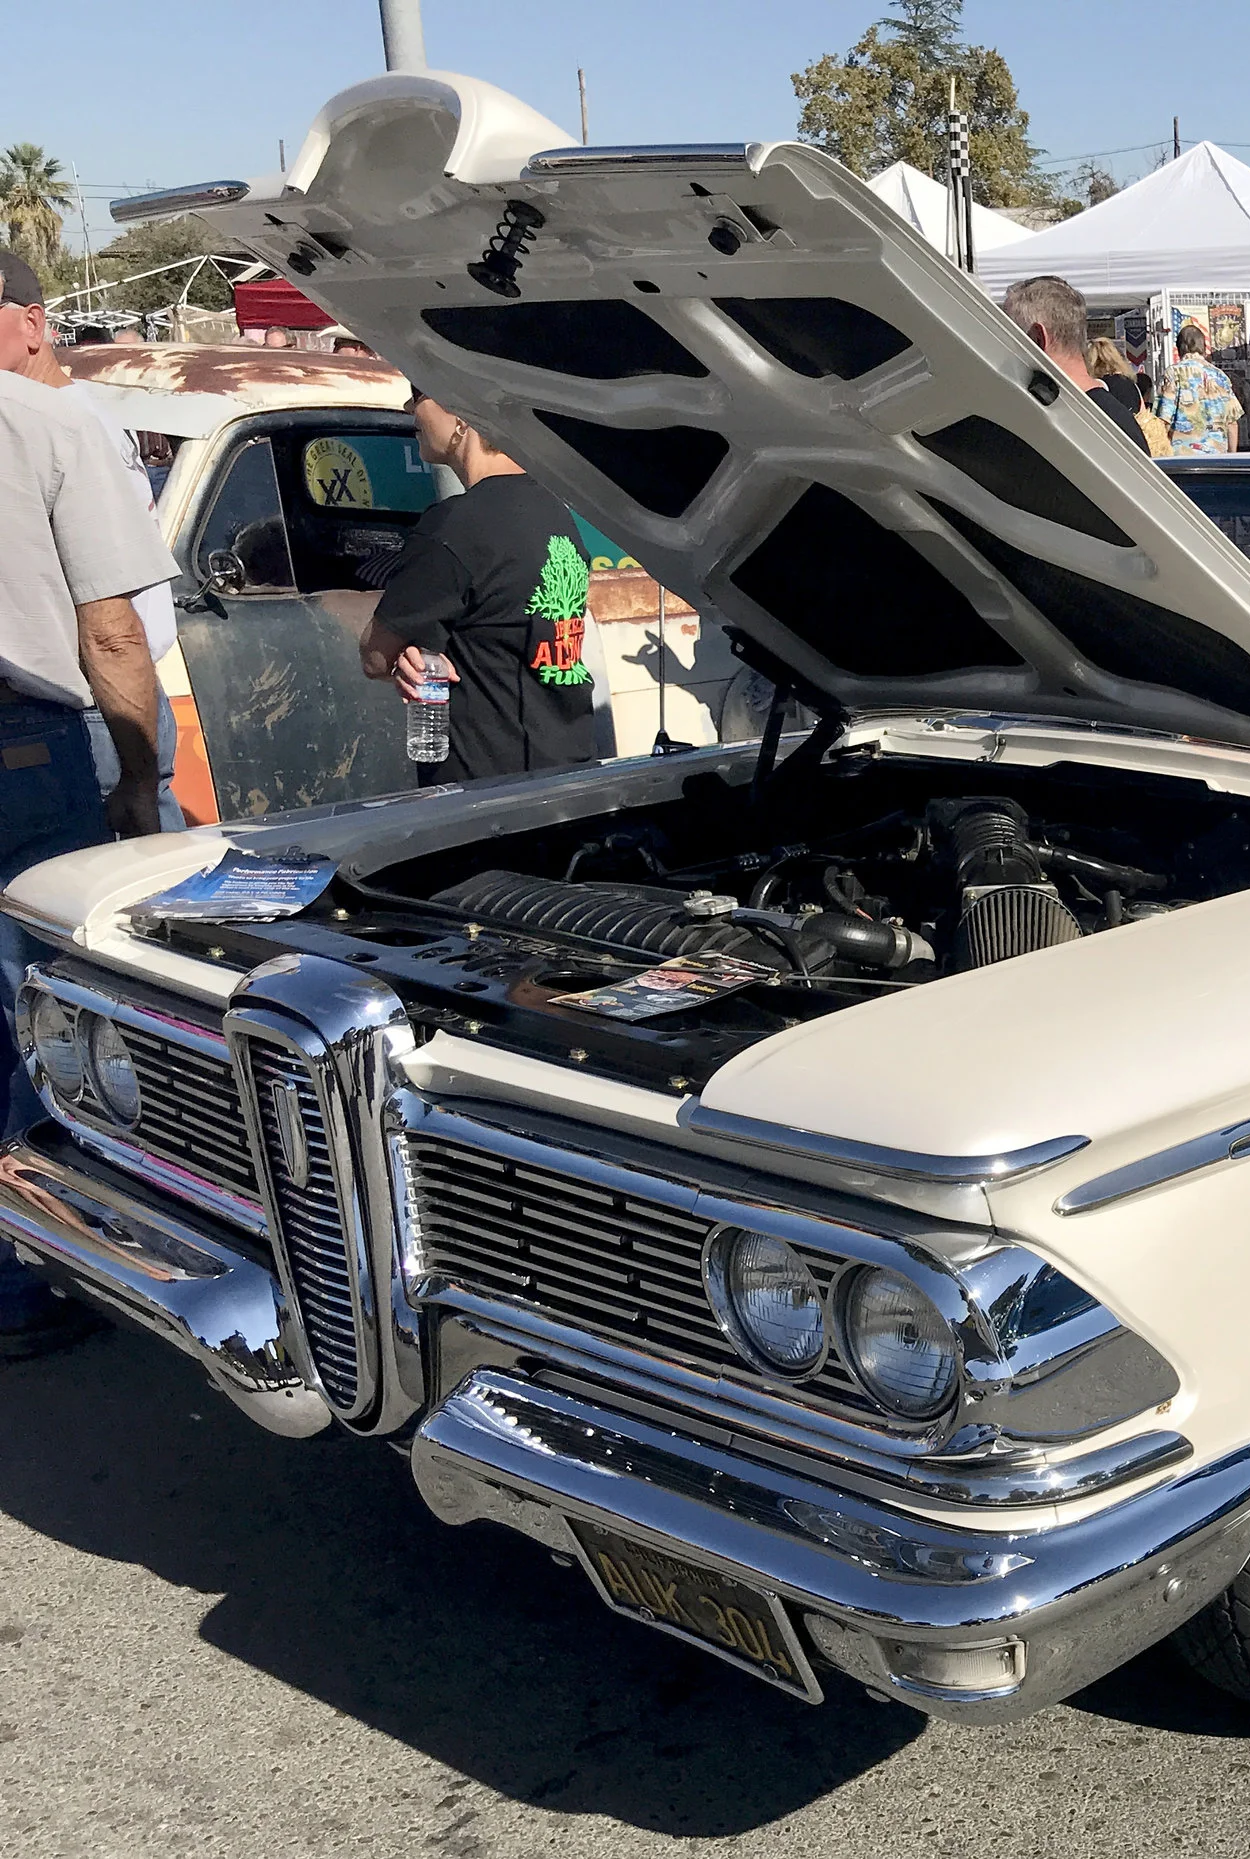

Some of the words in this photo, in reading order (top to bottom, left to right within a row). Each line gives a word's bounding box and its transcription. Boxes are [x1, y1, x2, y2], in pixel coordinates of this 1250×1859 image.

[310, 439, 335, 460] GREAT
[622, 1538, 721, 1591] CALIFORNIA
[598, 1551, 704, 1633] AUK
